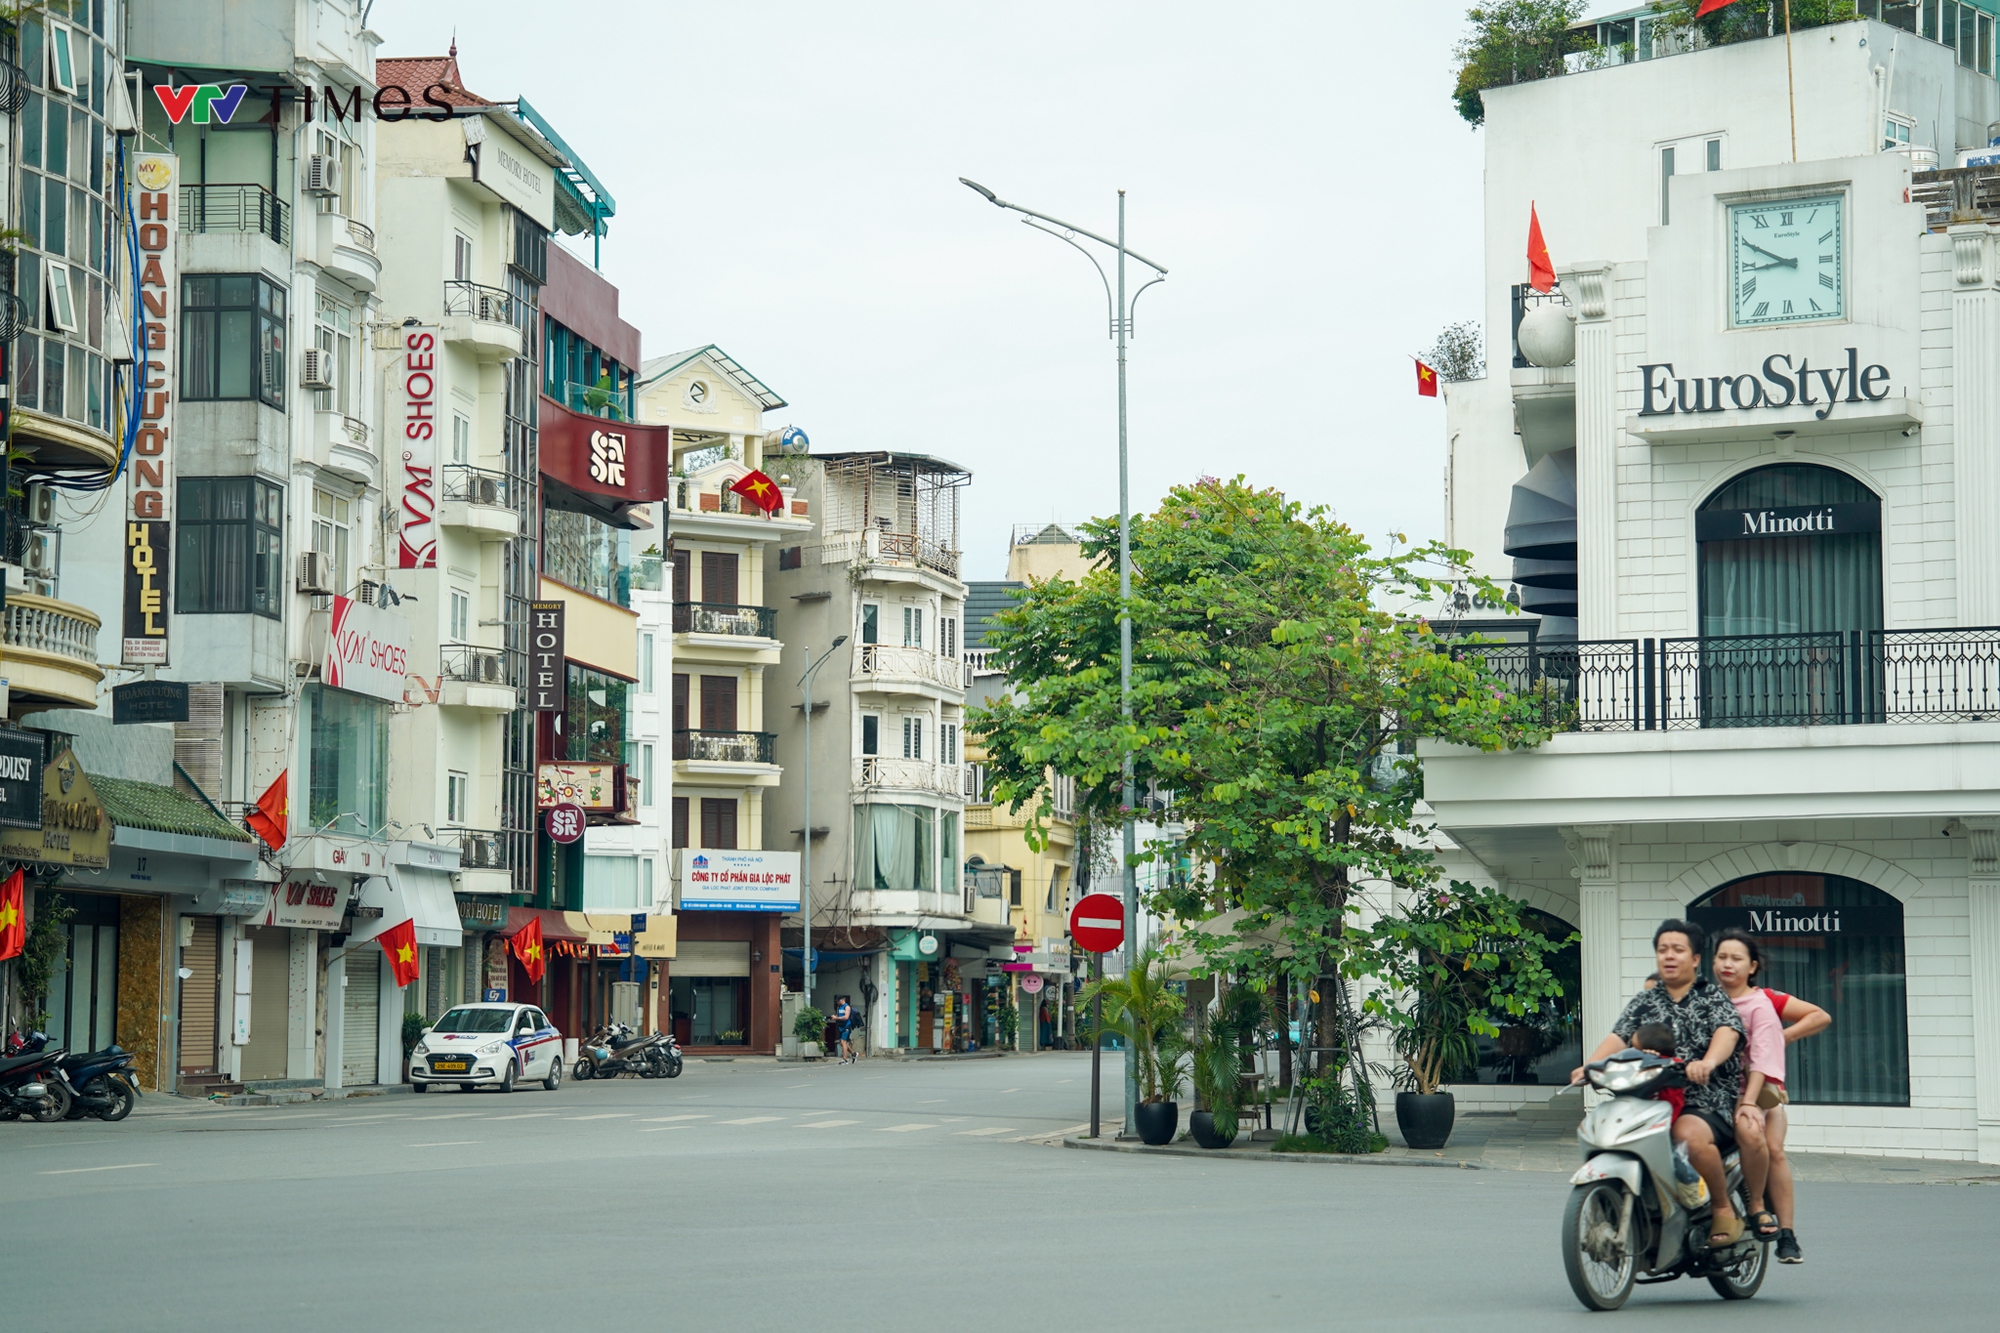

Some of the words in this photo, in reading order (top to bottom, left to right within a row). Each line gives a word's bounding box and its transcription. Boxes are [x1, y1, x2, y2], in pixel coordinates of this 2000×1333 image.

[139, 164, 156, 172] MV
[497, 147, 523, 180] MEMORY
[523, 166, 541, 194] HOTEL
[406, 333, 434, 440] SHOES
[1637, 348, 1891, 419] EuroStyle
[1742, 508, 1835, 535] Minotti
[129, 523, 165, 635] HOTEL
[370, 640, 406, 675] SHOES
[536, 613, 558, 708] HOTEL
[118, 686, 150, 701] HOÀNG
[129, 701, 173, 710] HOTEL
[43, 830, 71, 850] HOTEL
[137, 857, 147, 871] 17
[691, 870, 709, 882] CÔNG
[711, 872, 719, 882] TY
[749, 873, 760, 883] GIA
[762, 872, 774, 885] LỘC
[775, 871, 791, 884] PHÁT
[306, 884, 338, 908] SHOES
[476, 902, 502, 921] HOTEL
[1748, 910, 1841, 932] Minotti
